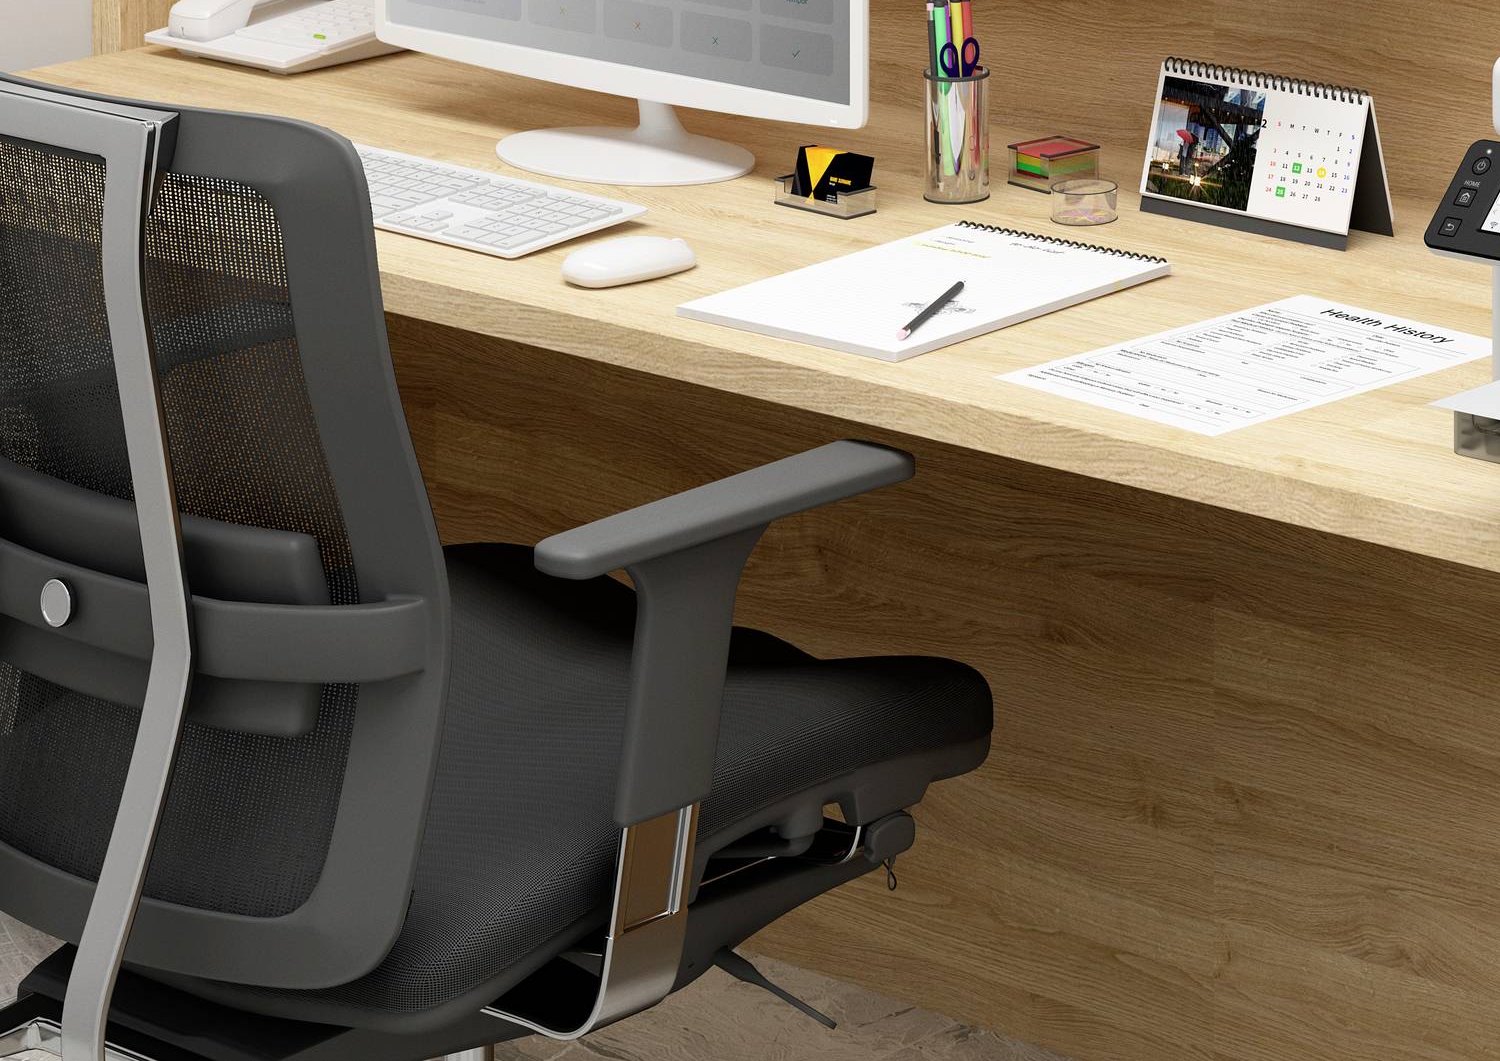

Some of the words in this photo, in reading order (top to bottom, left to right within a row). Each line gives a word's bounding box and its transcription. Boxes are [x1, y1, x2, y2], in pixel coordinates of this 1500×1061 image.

[1261, 118, 1268, 129] 2
[1463, 178, 1481, 188] HOME
[1319, 307, 1384, 328] Health
[1383, 323, 1456, 346] History
